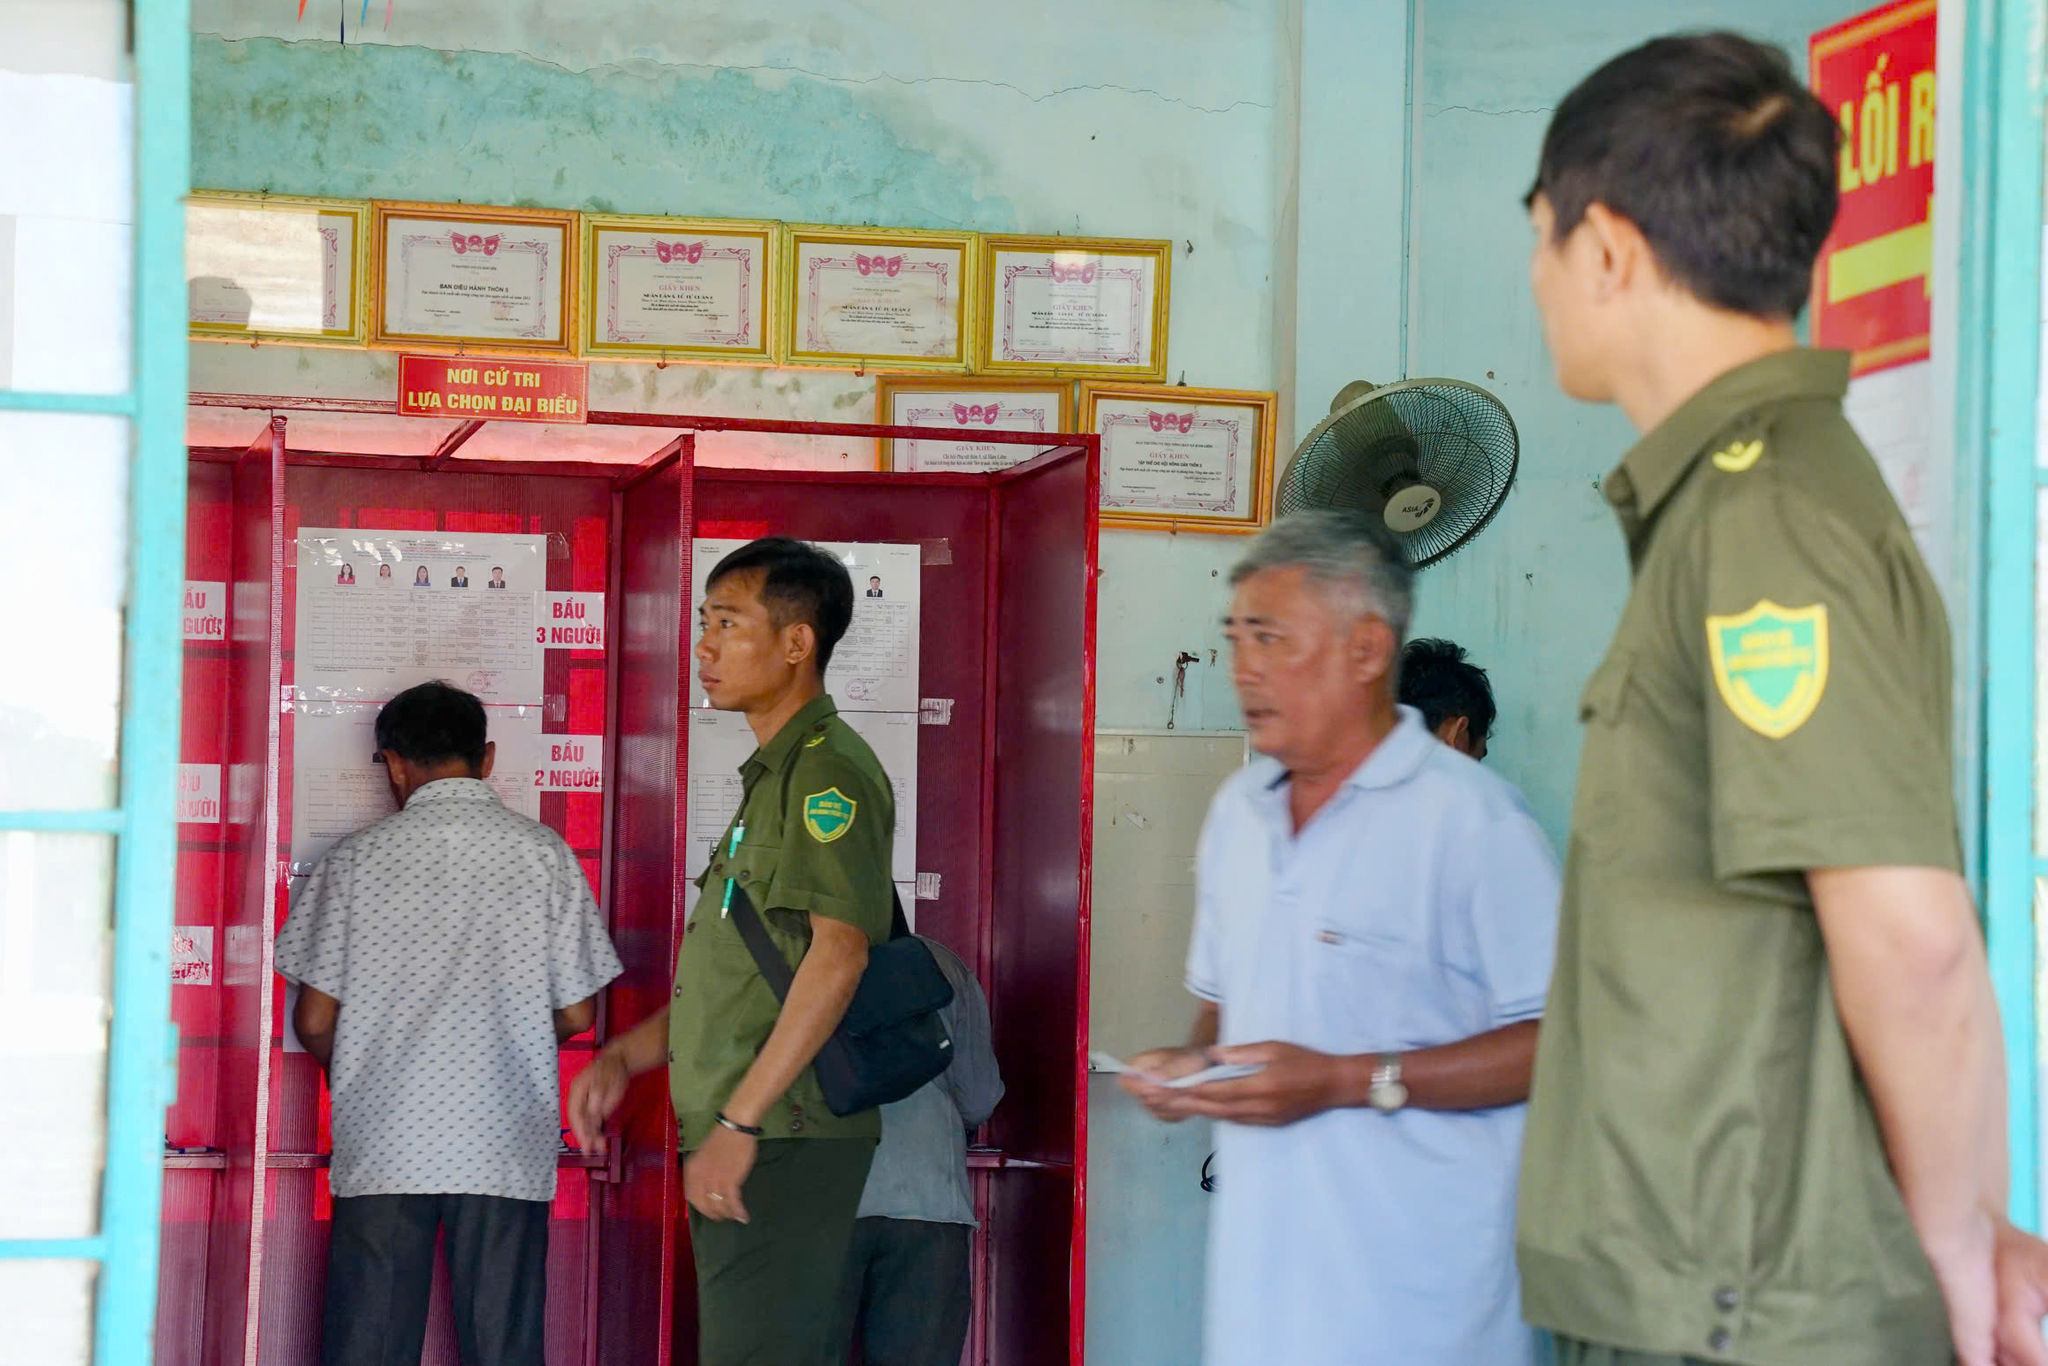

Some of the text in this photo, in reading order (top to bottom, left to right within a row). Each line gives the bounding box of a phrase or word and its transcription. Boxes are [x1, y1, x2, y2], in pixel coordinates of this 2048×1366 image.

[1840, 52, 1899, 193] LỐI
[447, 366, 541, 387] NƠI CỬ TRI
[408, 391, 578, 415] LỰA CHỌN ĐẠI BIỂU
[1402, 504, 1419, 513] ASIA
[552, 596, 585, 619] BẦU
[536, 624, 601, 644] 3 NGƯỜI
[551, 739, 585, 762] BẦU
[534, 767, 600, 787] 2 NGƯỜI
